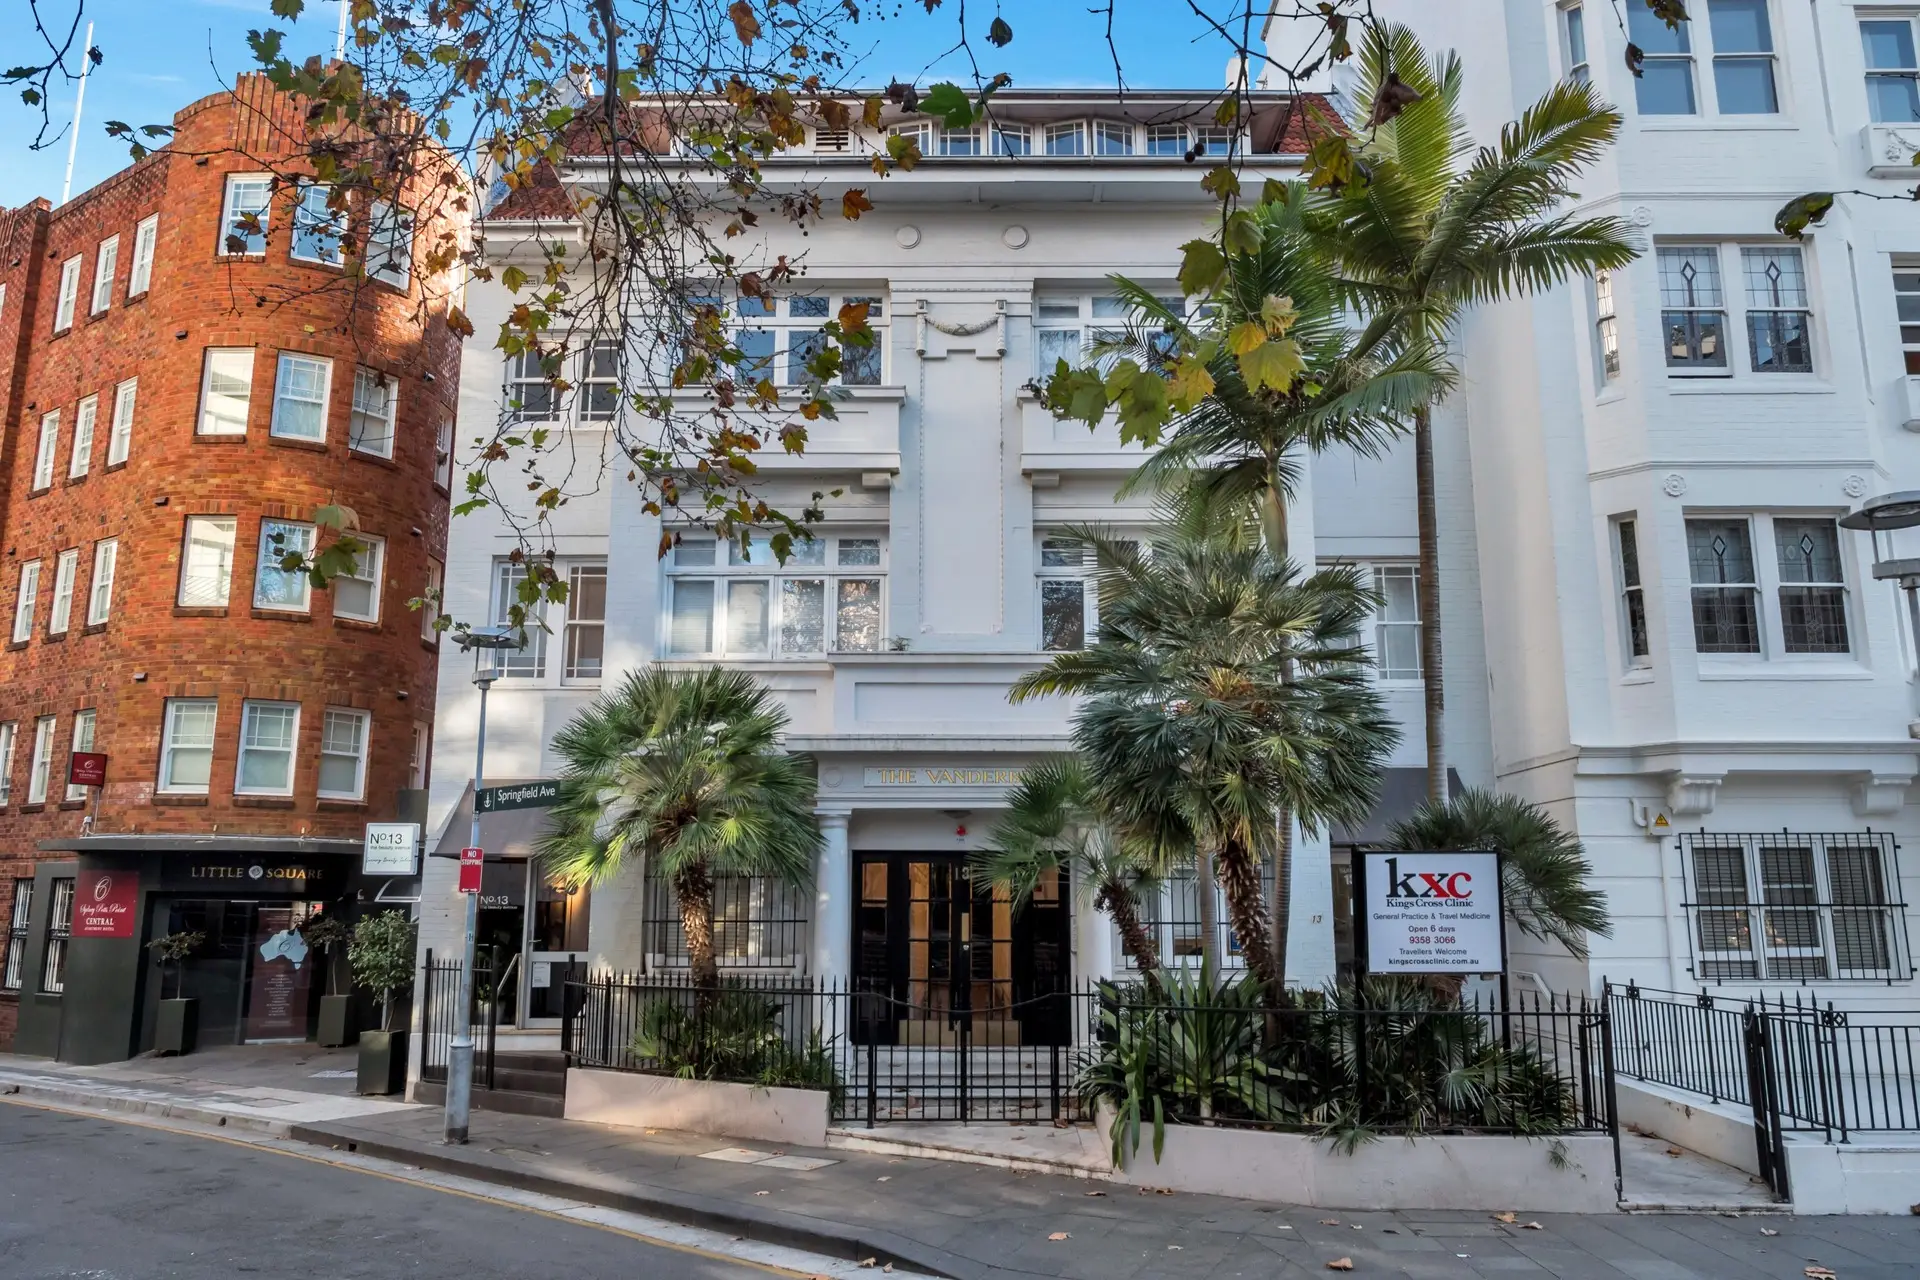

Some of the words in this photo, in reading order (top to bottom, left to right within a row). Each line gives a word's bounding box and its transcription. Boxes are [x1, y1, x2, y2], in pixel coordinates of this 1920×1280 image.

[878, 769, 917, 784] THE
[925, 769, 1022, 784] VANDERB
[497, 786, 538, 804] Springfield
[539, 785, 556, 797] Ave
[467, 850, 477, 858] NO
[191, 866, 245, 878] LITTLE
[266, 867, 323, 880] SQUARE
[955, 866, 970, 881] 13
[1384, 857, 1473, 899] kxc
[1386, 898, 1414, 909] Kings
[1415, 898, 1443, 908] Cross
[1445, 898, 1474, 908] Clinic
[1311, 914, 1322, 924] 13
[1373, 912, 1400, 920] General
[1401, 912, 1429, 920] Practice
[1439, 912, 1458, 920] Travel
[1459, 912, 1491, 920] Medicine
[85, 917, 114, 926] CENTRAL
[1408, 925, 1428, 934] Open
[1430, 924, 1436, 933] 6
[1438, 925, 1456, 934] days
[1409, 936, 1431, 944] 9358
[1433, 936, 1456, 944] 3066
[1399, 947, 1432, 955] Travellers
[1434, 947, 1468, 955] Welcome
[1388, 957, 1480, 966] kingscrossclinic.com.au
